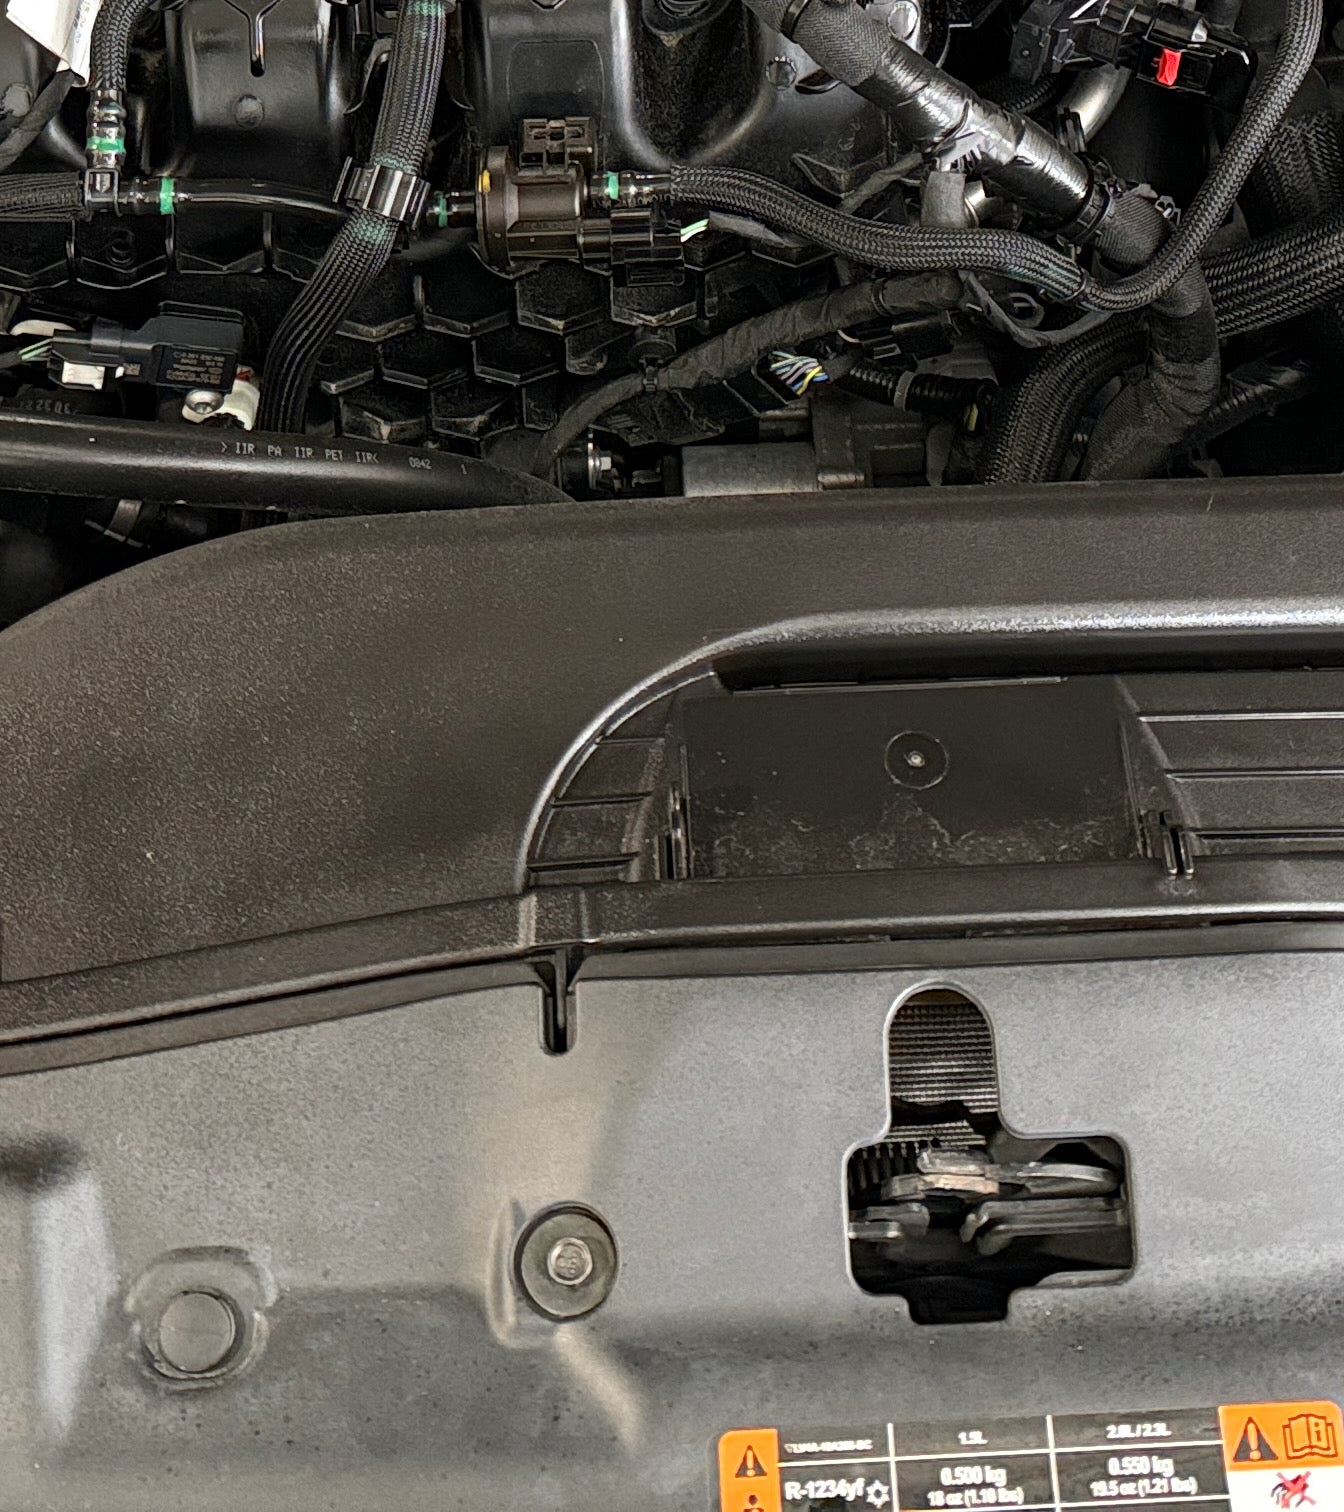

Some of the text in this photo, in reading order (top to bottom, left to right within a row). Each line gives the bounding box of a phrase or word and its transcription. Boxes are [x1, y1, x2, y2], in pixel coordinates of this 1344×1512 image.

[267, 444, 283, 458] PA
[324, 449, 344, 462] PET
[940, 1465, 1007, 1486] 0.500 kg
[1108, 1455, 1174, 1476] 0.550 kg
[784, 1478, 866, 1501] R-1234yf
